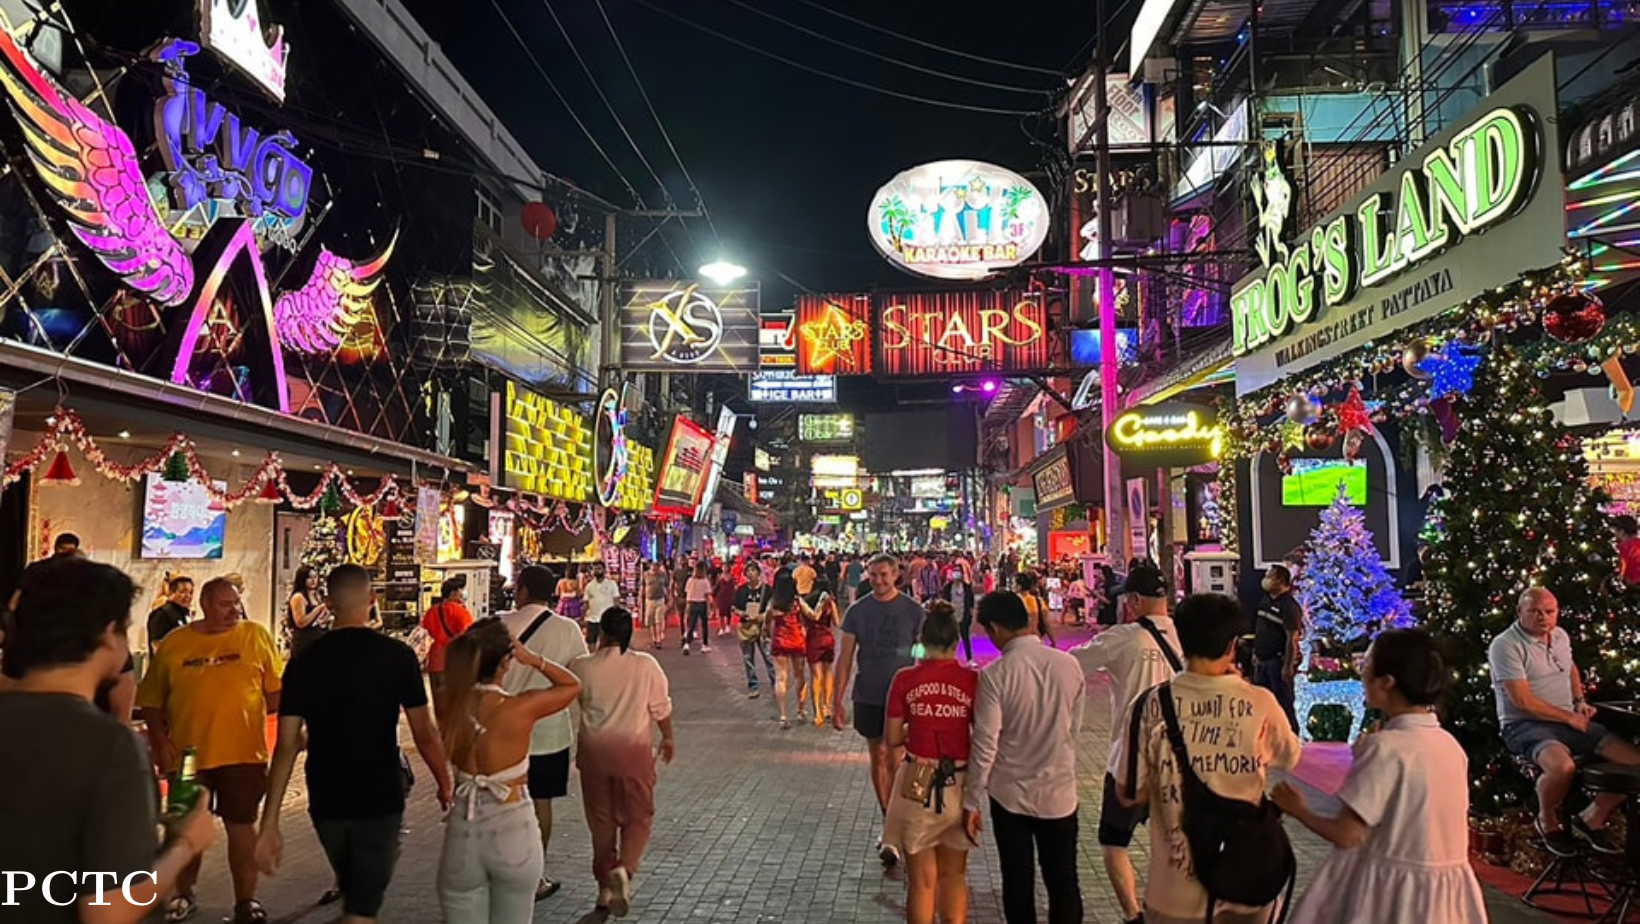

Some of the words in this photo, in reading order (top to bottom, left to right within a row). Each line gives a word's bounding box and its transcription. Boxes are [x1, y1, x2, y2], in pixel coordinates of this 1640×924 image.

[1073, 163, 1152, 194] STRS
[1230, 215, 1351, 358] FROG'S
[1357, 107, 1526, 288] LAND
[903, 245, 982, 264] KARAOKE
[984, 242, 1018, 261] BAR
[1380, 267, 1455, 321] PATTAYA
[800, 318, 866, 343] STARS
[882, 299, 1043, 348] STARS
[905, 681, 941, 704] SEAFOOD
[940, 682, 949, 696] &
[946, 683, 973, 708] STEAK
[909, 701, 934, 717] SEA
[934, 702, 968, 718] ZONE
